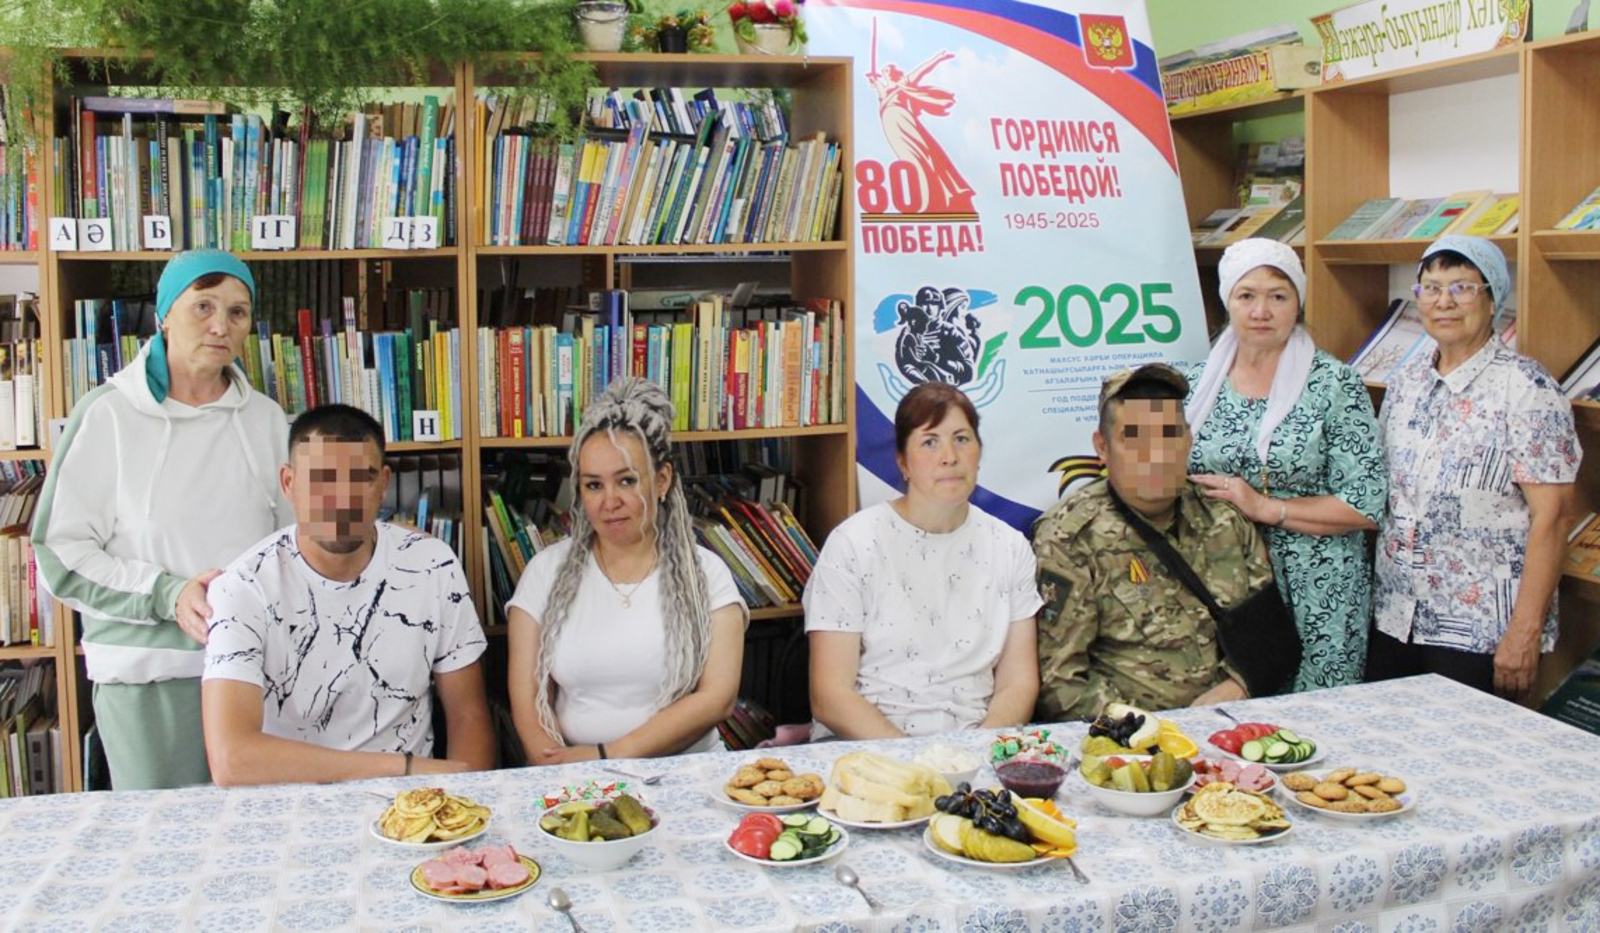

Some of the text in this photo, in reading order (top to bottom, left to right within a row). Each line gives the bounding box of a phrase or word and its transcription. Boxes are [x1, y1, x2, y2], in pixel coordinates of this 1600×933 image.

[990, 118, 1120, 159] ГОРДИМСЯ
[855, 160, 923, 214] 80
[1000, 157, 1122, 204] ПОБЕДОЙ!
[151, 220, 166, 239] Б
[274, 219, 290, 238] Г
[1003, 212, 1100, 229] 1945-2025
[56, 223, 72, 241] А
[87, 223, 105, 244] Ә
[387, 221, 405, 242] Д
[861, 225, 985, 257] ПОБЕДА!
[1014, 283, 1182, 349] 2025
[1112, 351, 1164, 360] ОПЕРАЦИЯЛА
[1051, 394, 1099, 403] ГОД ПОДДЕ
[1041, 404, 1099, 414] СПЕЦИАЛЬНО
[419, 418, 435, 435] Н
